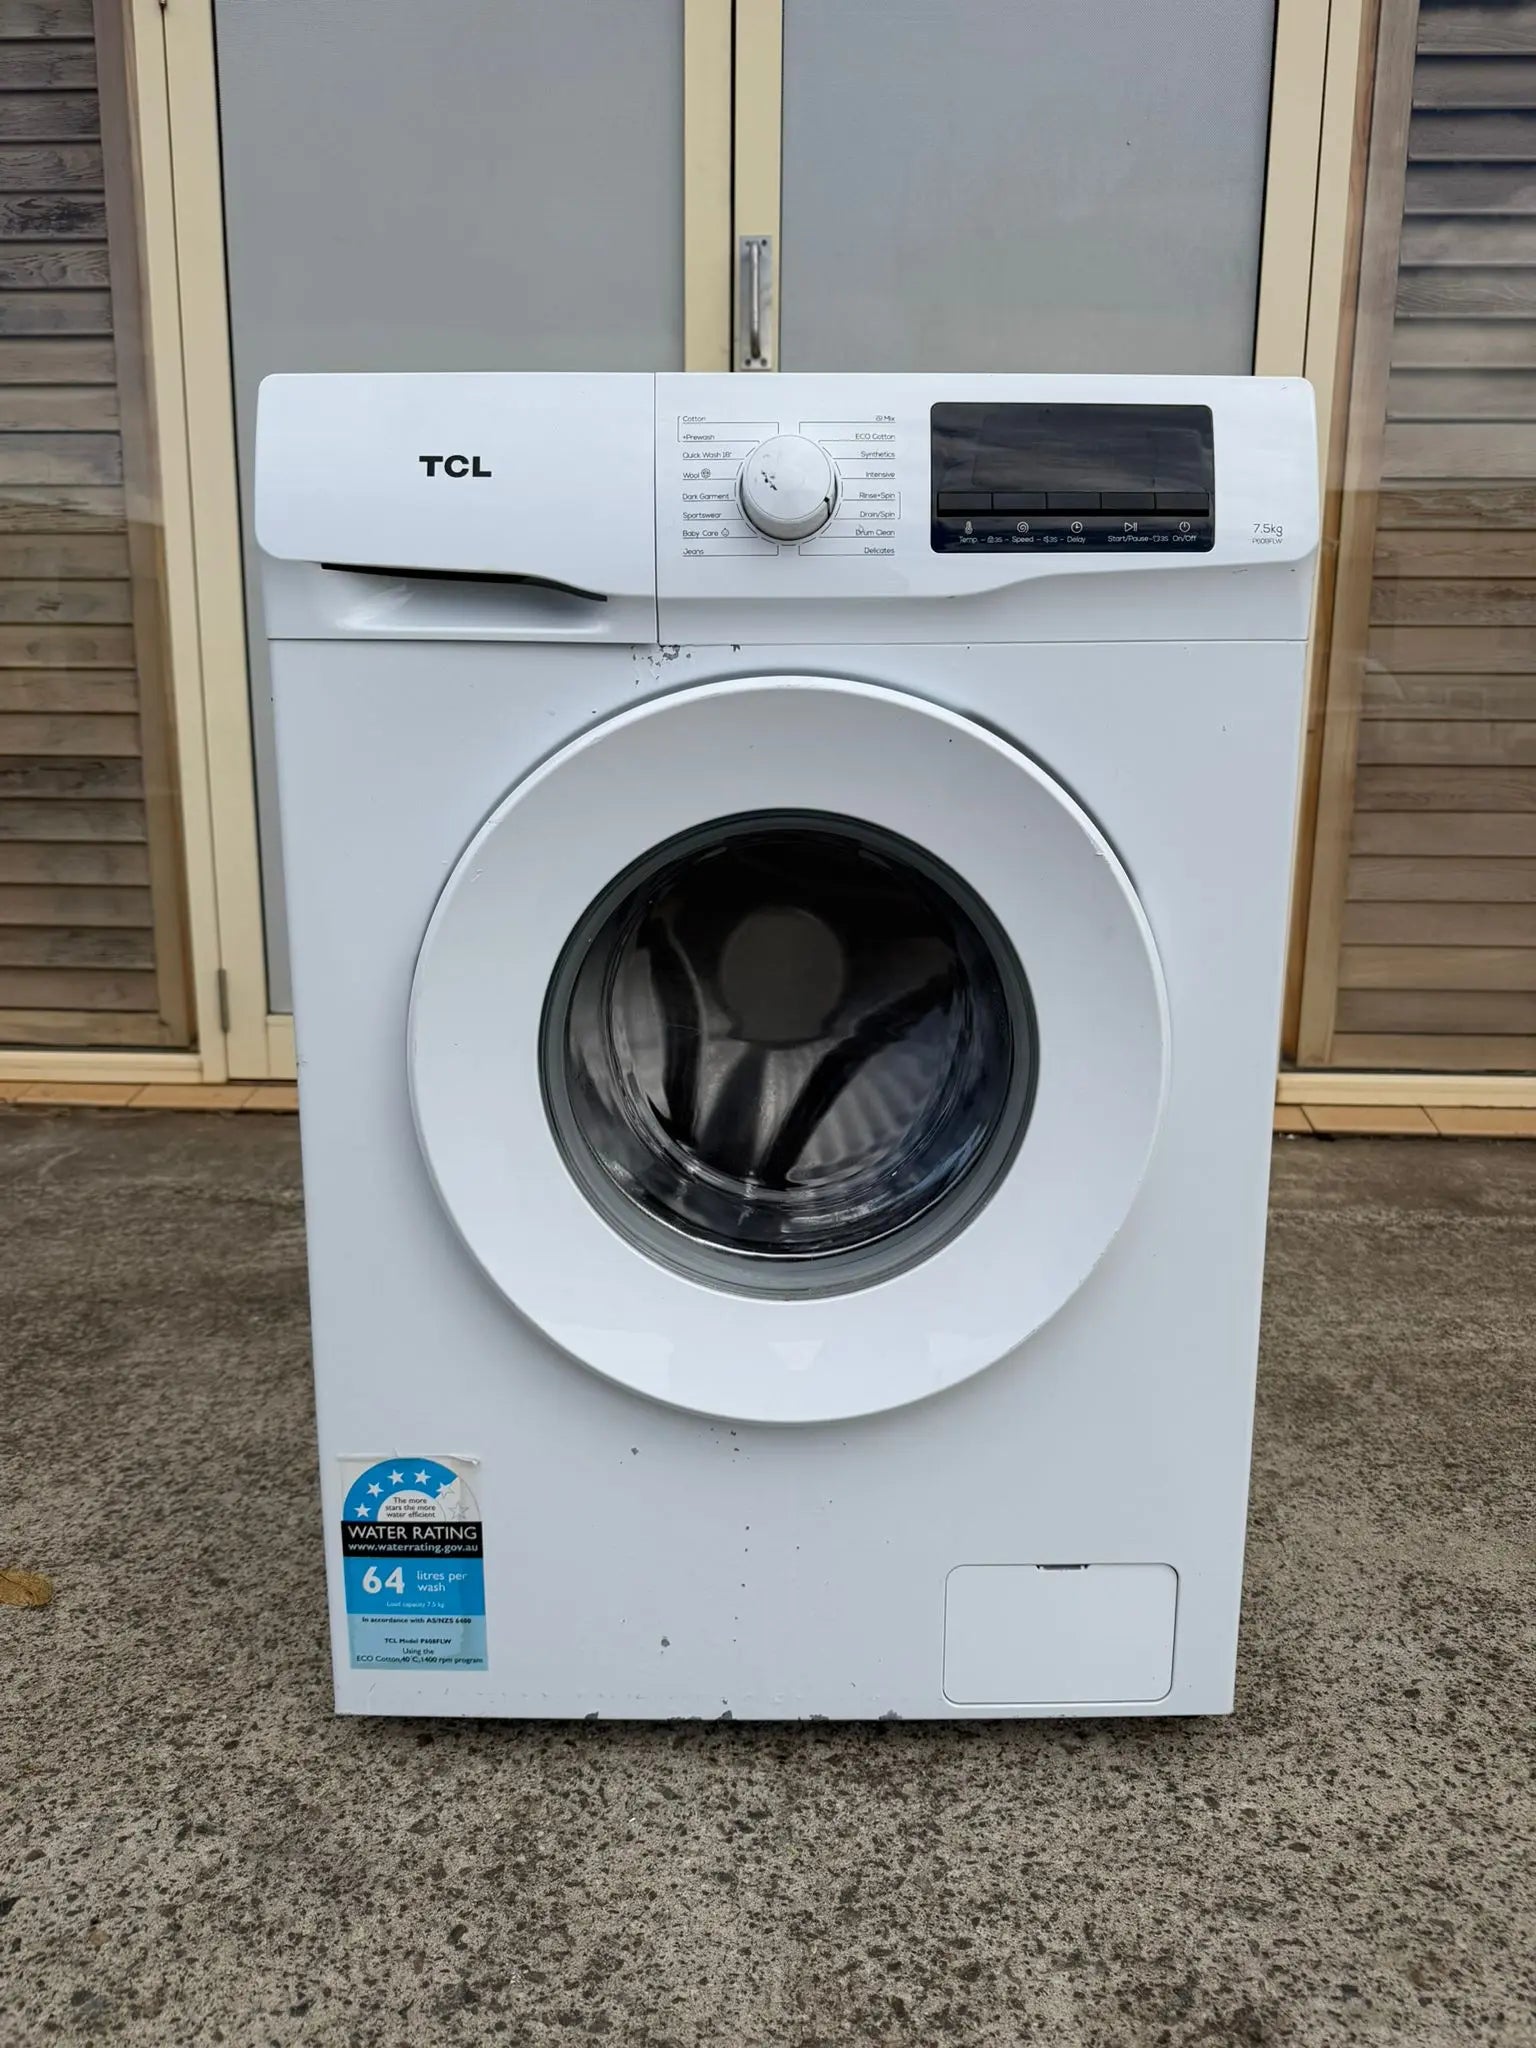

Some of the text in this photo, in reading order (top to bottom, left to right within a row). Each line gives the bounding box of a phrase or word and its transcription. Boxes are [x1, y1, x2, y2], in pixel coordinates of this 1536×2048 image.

[682, 451, 700, 459] Quick
[860, 451, 895, 459] Synthetics
[419, 455, 492, 478] TCL
[682, 512, 722, 520] Sportswear
[860, 511, 895, 519] Drain/Spin
[682, 530, 700, 539] Baby
[1253, 523, 1283, 537] 7.5kg
[960, 536, 978, 544] Temp
[1012, 536, 1034, 544] Speed
[1067, 536, 1086, 544] Delay
[348, 1526, 477, 1540] WATER RATING
[348, 1543, 478, 1554] www.waterrating.gov.au
[362, 1566, 405, 1594] 64
[416, 1571, 467, 1583] litres per
[417, 1583, 446, 1592] wash
[403, 1648, 422, 1656] Using
